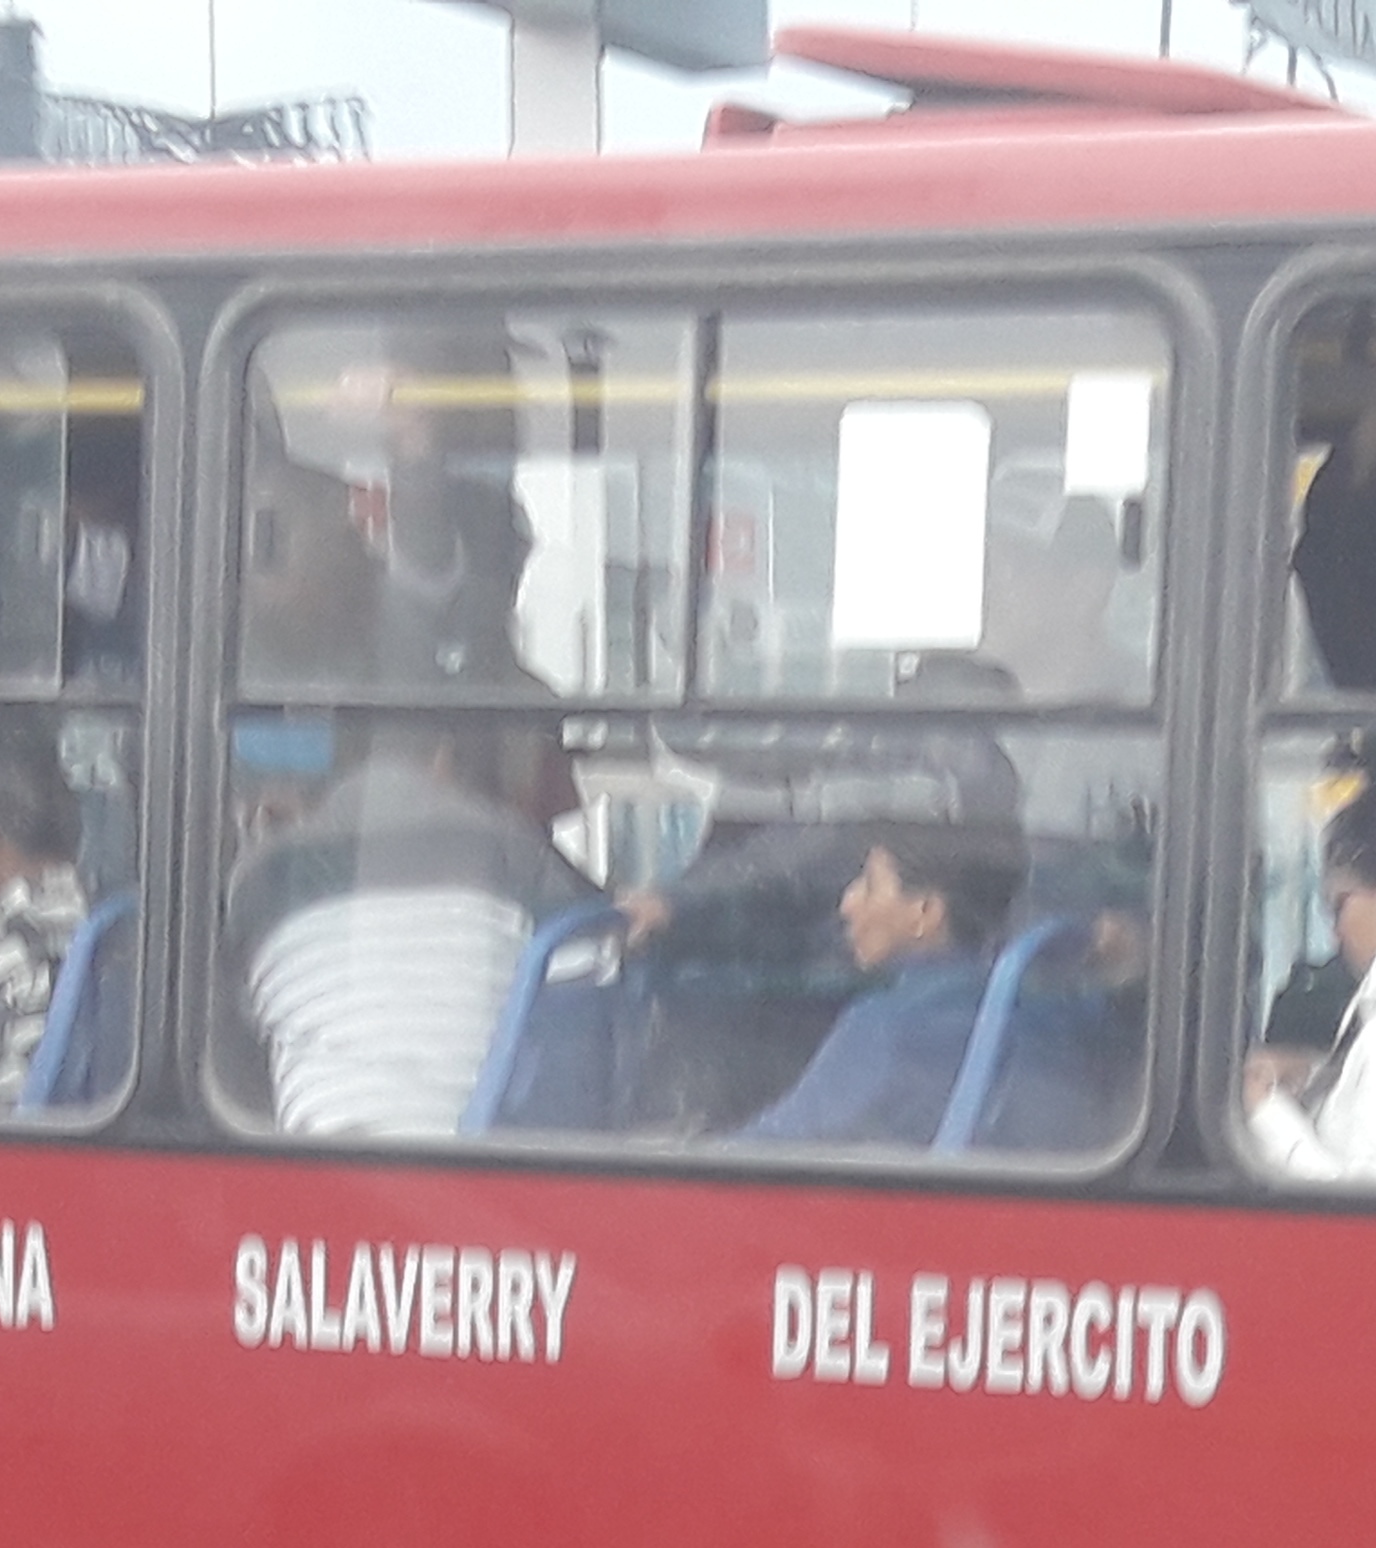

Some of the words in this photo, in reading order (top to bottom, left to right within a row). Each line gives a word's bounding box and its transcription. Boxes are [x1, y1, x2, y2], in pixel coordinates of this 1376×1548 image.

[232, 1232, 579, 1364] SALAVERRY
[770, 1264, 891, 1385] DEL
[907, 1272, 1227, 1408] EJERCITO
